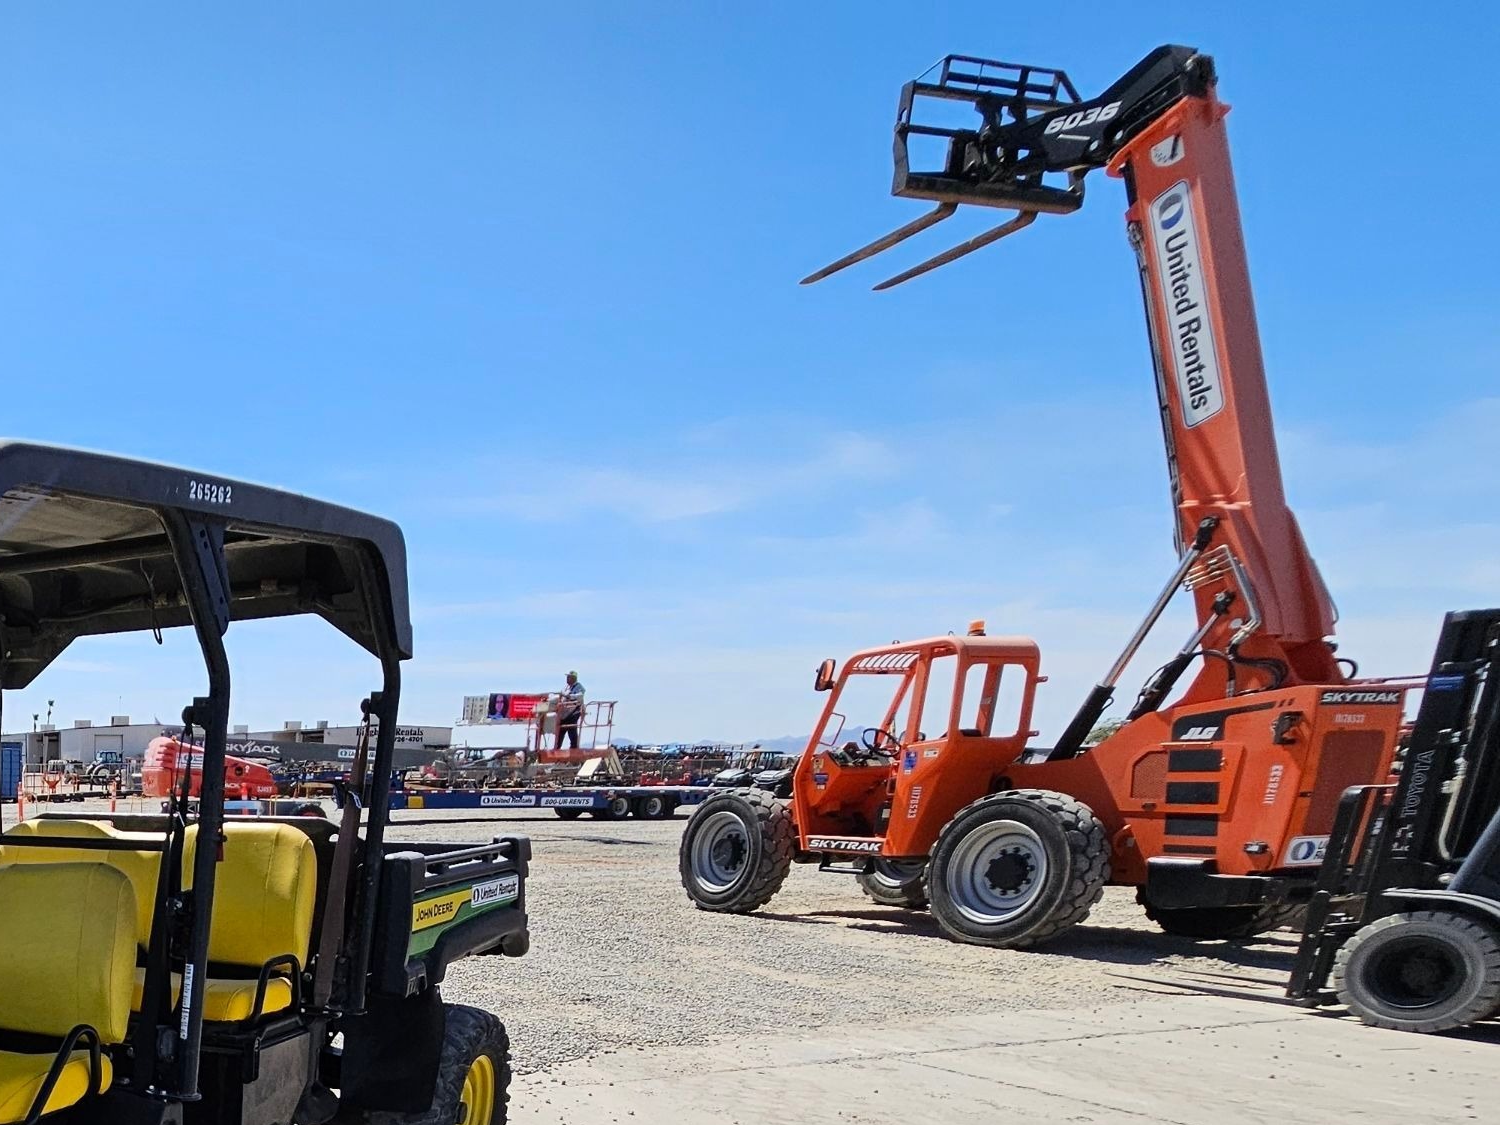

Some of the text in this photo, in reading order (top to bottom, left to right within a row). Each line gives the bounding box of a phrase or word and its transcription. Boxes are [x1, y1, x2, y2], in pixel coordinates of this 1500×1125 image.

[1044, 100, 1122, 135] 6036
[1165, 229, 1213, 411] United Rentals
[189, 480, 232, 504] 265262
[1321, 692, 1399, 704] SKYTRAK
[395, 727, 424, 737] Rentals
[1179, 726, 1219, 740] JLG
[225, 740, 280, 754] SKYJACK
[1401, 749, 1436, 818] TOYOTA
[491, 796, 511, 804] United
[907, 786, 923, 819] 11178533
[808, 839, 882, 851] SKYTRAK
[480, 884, 498, 900] United
[416, 901, 454, 922] JOHN DEERE
